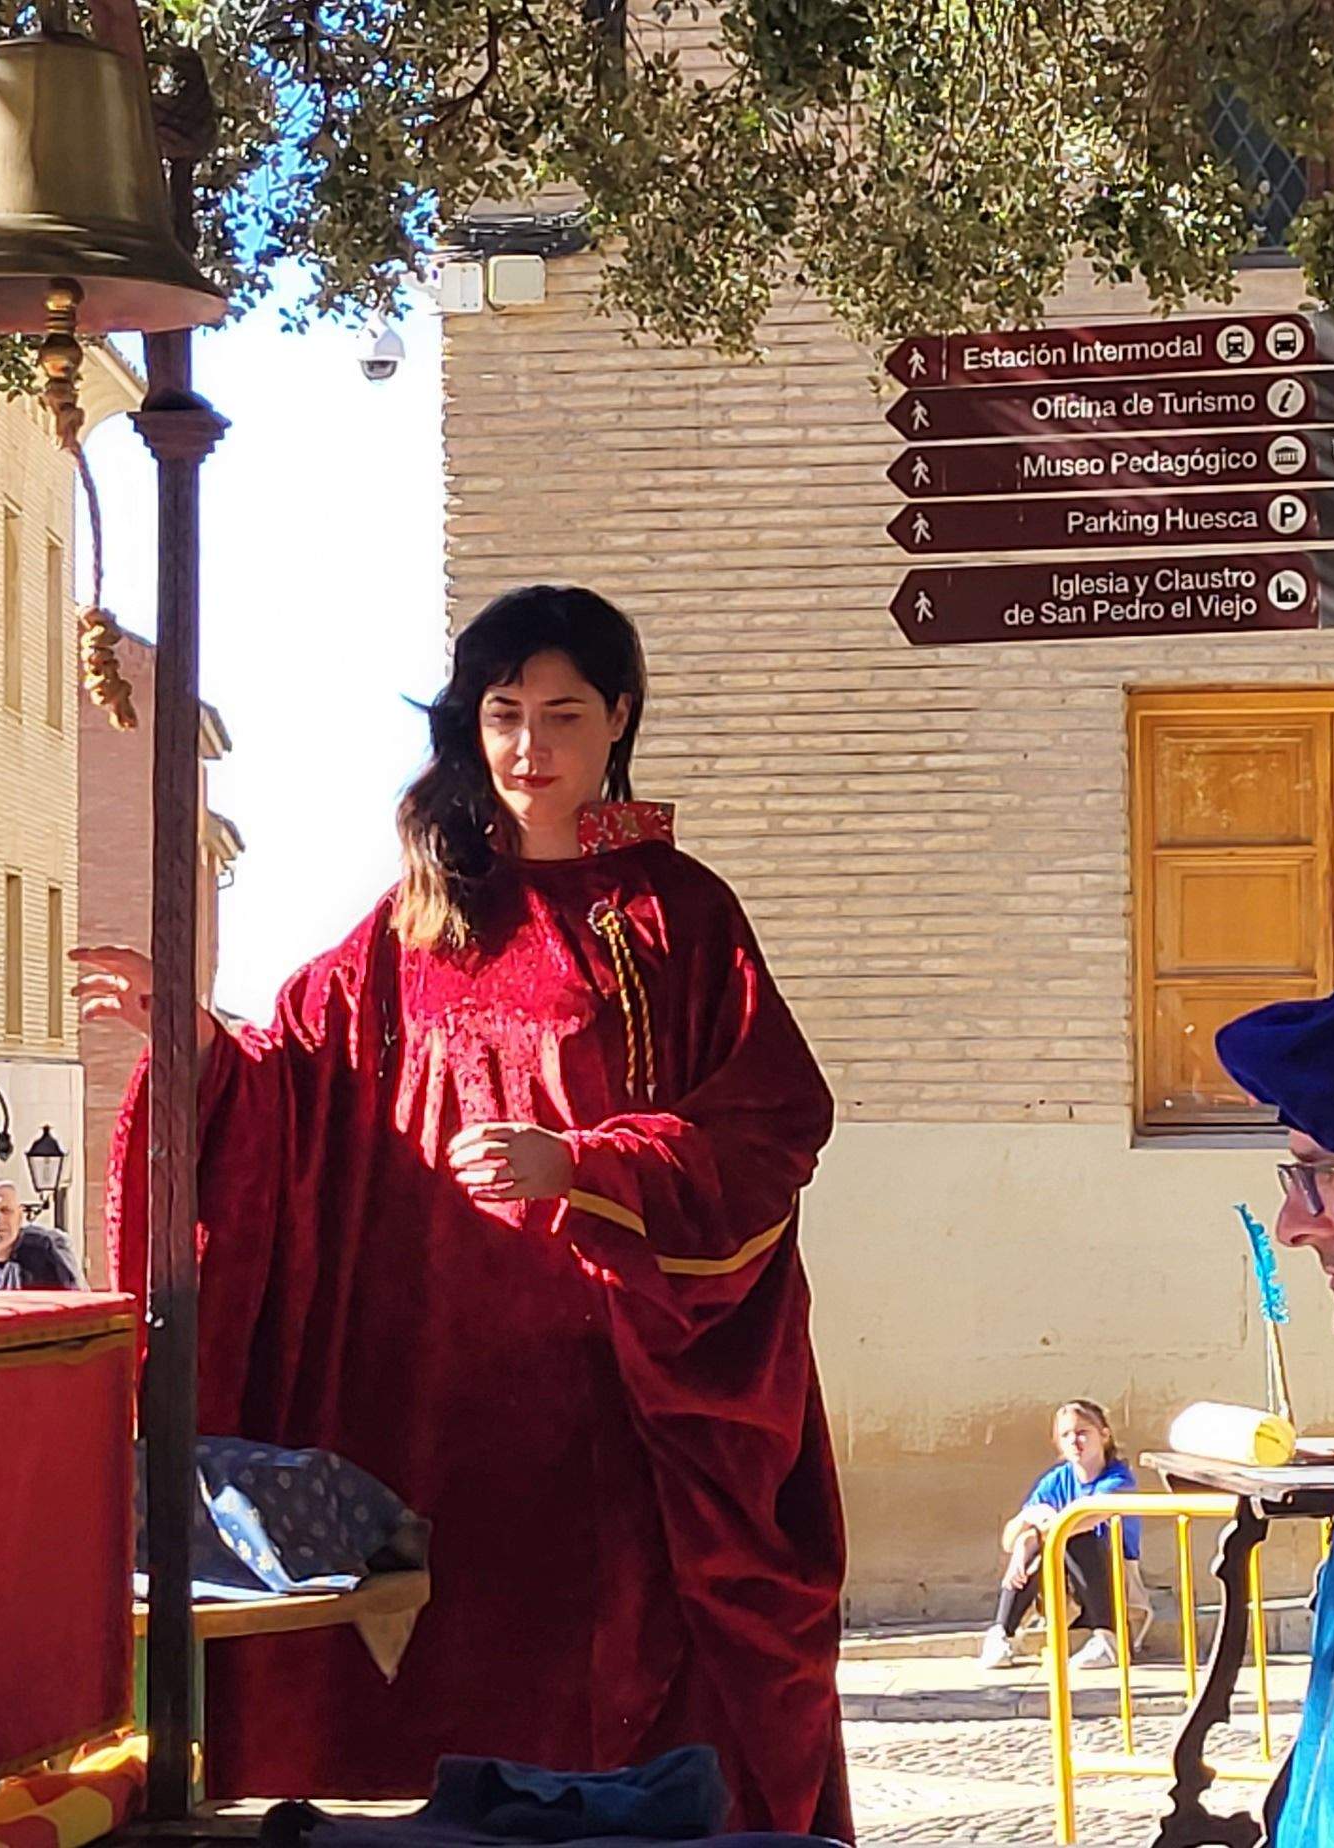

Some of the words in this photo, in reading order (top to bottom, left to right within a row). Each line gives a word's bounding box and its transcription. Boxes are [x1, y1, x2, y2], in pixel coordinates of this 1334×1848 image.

[963, 345, 1067, 371] Estación
[1073, 335, 1203, 364] Intermodal
[1032, 396, 1117, 421] Oficina
[1123, 394, 1154, 415] de
[1158, 392, 1256, 414] Turismo
[1023, 453, 1104, 479] Museo
[1111, 448, 1258, 475] Pedagógico
[1067, 510, 1158, 536] Parking
[1165, 508, 1258, 530] Huesca
[1280, 503, 1297, 526] P
[1053, 572, 1129, 599] Iglesia
[1133, 574, 1147, 596] y
[1156, 568, 1256, 592] Claustro
[1004, 604, 1035, 626] de
[1040, 601, 1086, 622] San
[1093, 598, 1165, 622] Pedro
[1171, 596, 1192, 618] el
[1196, 593, 1257, 622] Viejo
